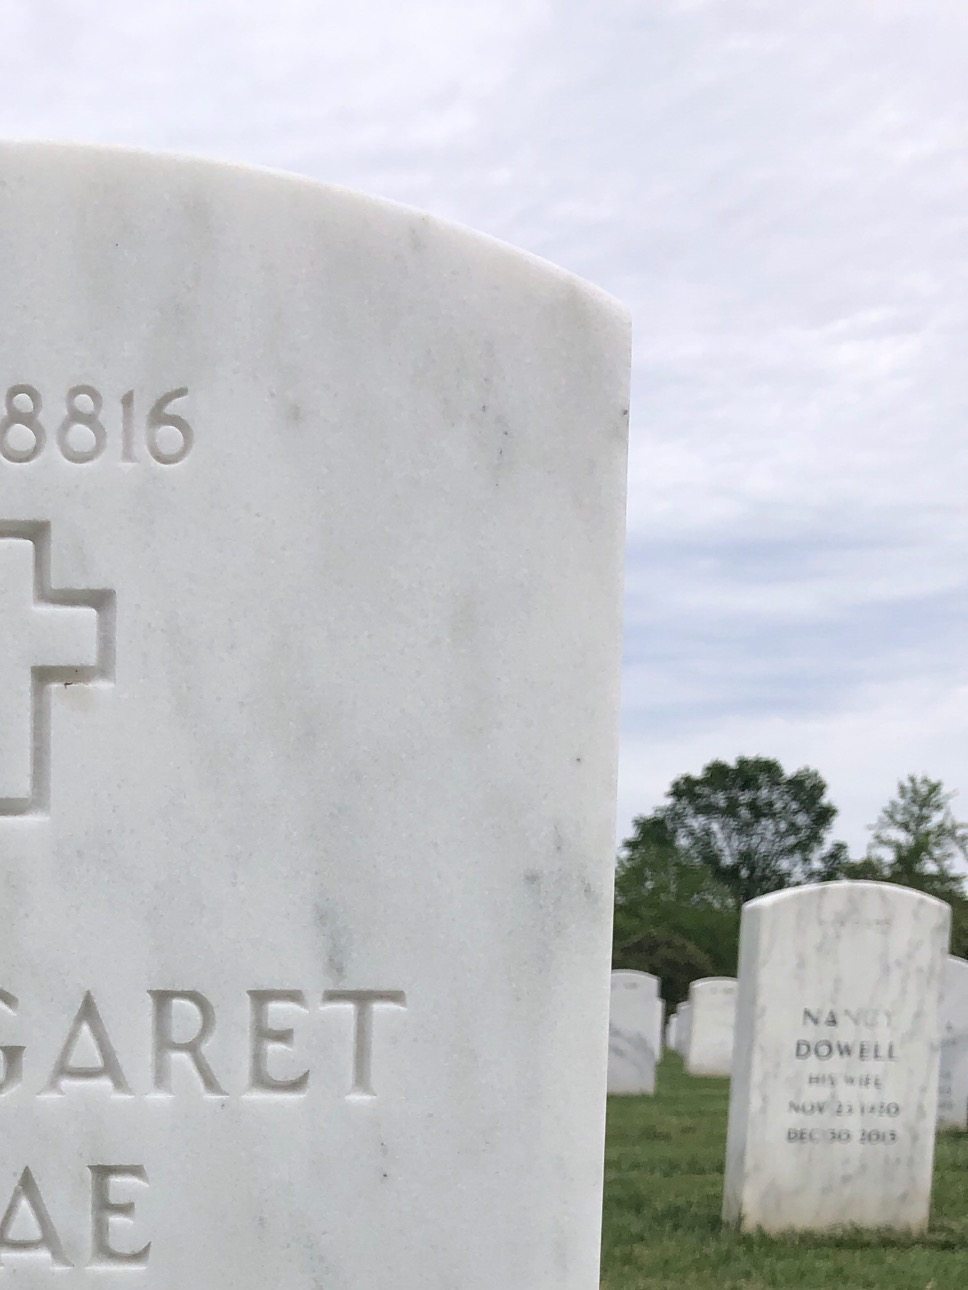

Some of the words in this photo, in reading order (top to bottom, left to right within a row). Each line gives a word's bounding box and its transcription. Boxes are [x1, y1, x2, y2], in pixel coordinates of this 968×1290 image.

[795, 1039, 898, 1061] DOWELL
[789, 1101, 825, 1116] NOV
[787, 1128, 821, 1144] DEC
